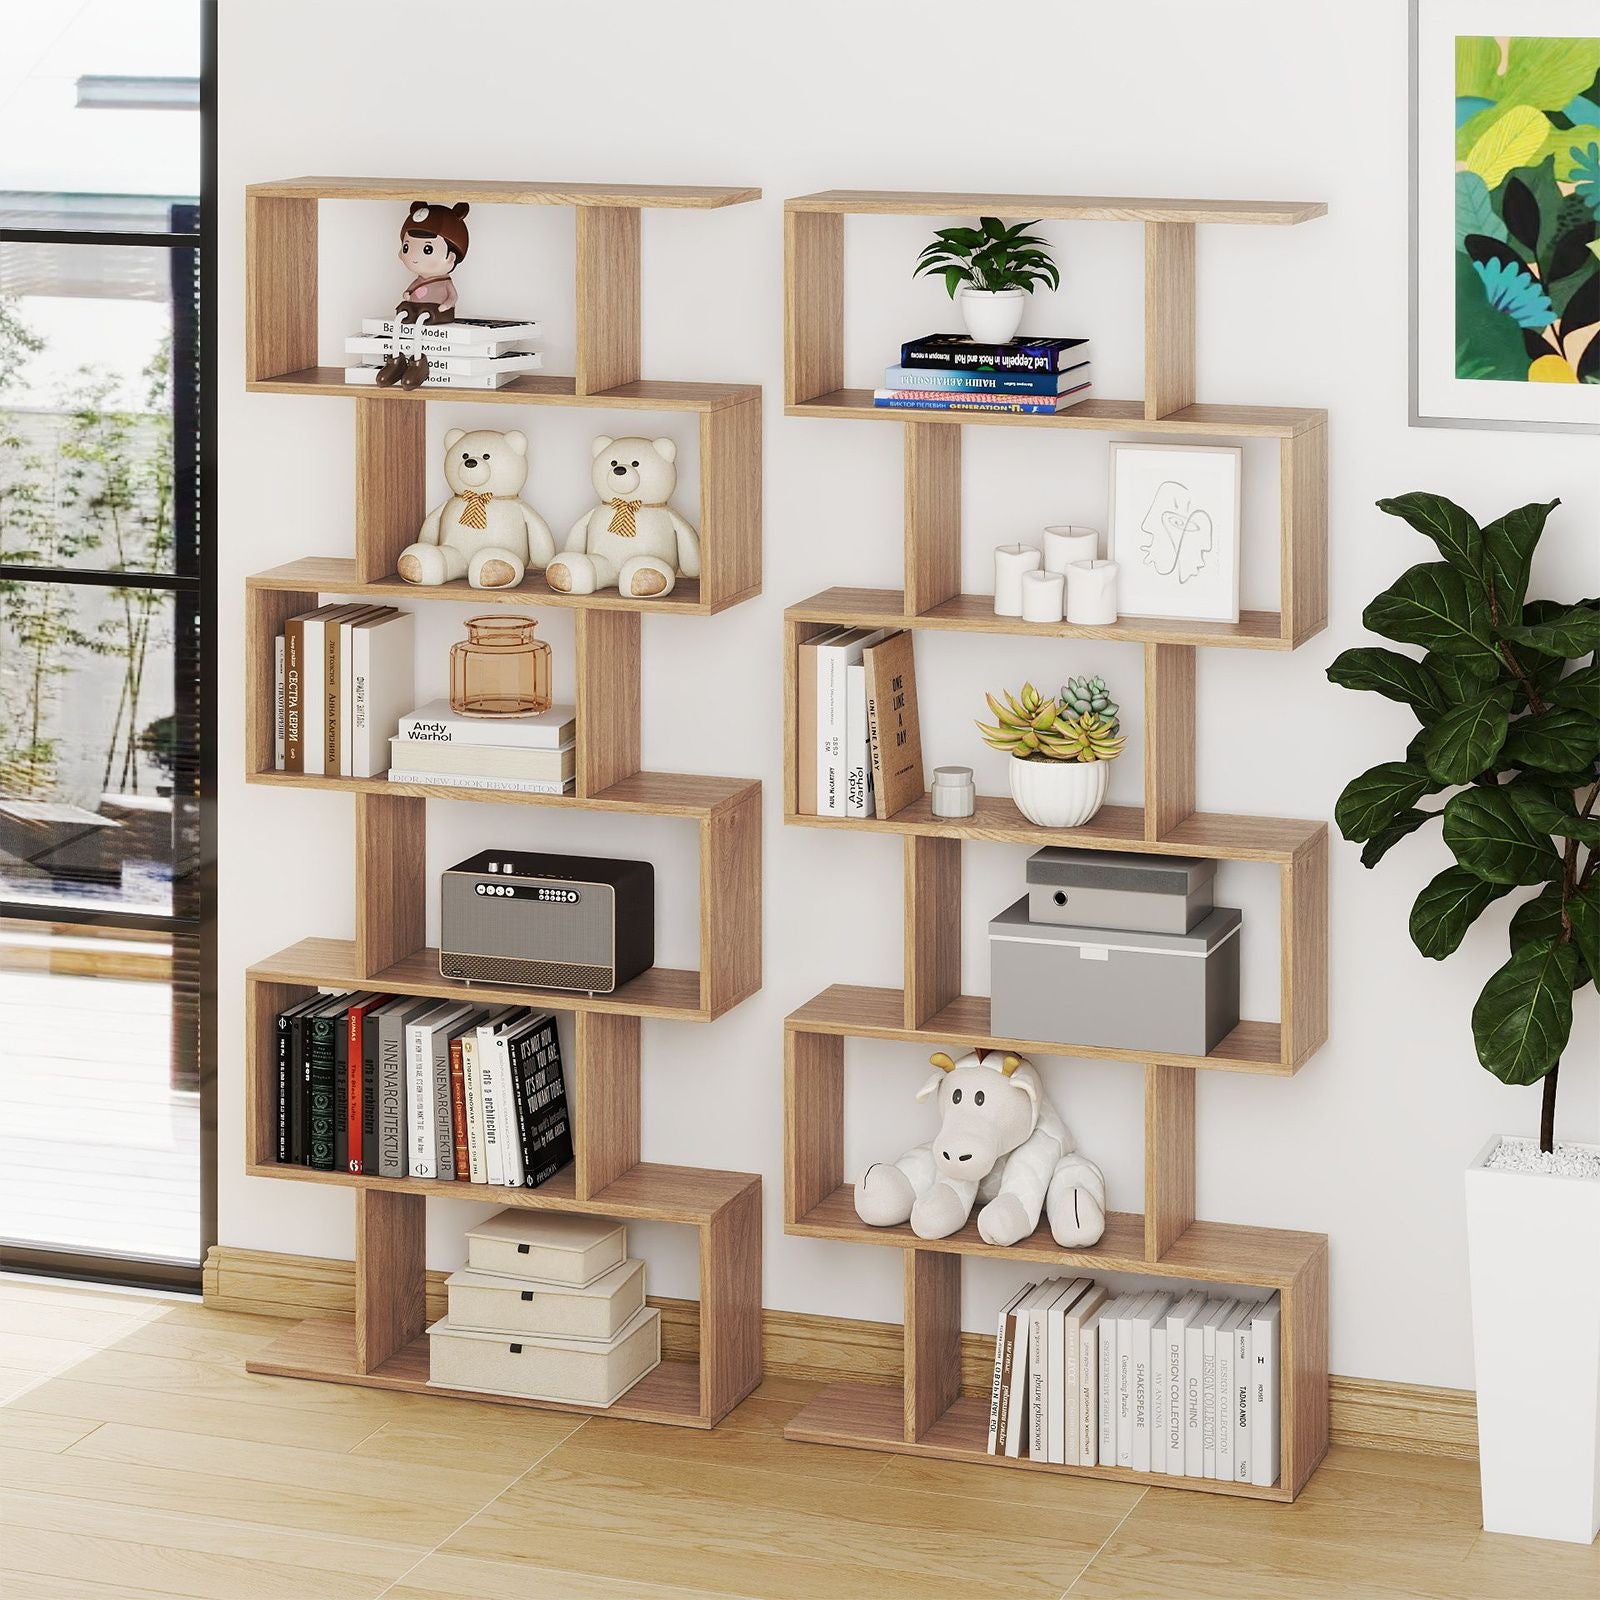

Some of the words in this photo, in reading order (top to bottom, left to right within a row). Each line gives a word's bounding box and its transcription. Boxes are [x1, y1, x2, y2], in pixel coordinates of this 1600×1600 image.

[383, 322, 414, 336] Balor
[421, 344, 450, 352] Model
[428, 360, 448, 370] odel
[954, 353, 966, 364] Roll
[967, 354, 978, 364] and
[979, 355, 994, 366] Rock
[995, 355, 1001, 366] in
[1002, 353, 1033, 368] Zeppelin
[1034, 355, 1049, 369] Led
[965, 379, 996, 388] НАШИ
[288, 670, 298, 707] СЕСТРА
[892, 674, 904, 692] ONE
[893, 692, 905, 711] LINE
[288, 710, 298, 742] КЕРРИ
[413, 722, 446, 733] Andy
[898, 712, 903, 728] A
[408, 731, 452, 742] Warhol
[897, 729, 907, 747] DAY
[825, 741, 831, 752] WS
[425, 776, 450, 785] NEW
[453, 778, 483, 787] LOOK
[486, 780, 559, 793] REVOLUTION
[848, 771, 857, 803] Andy
[856, 766, 864, 809] Warhol
[482, 1069, 492, 1085] arts
[384, 1039, 398, 1167] INNENARCHITEKTUR
[435, 1056, 451, 1171] INNENARCHITEKTUR
[485, 1097, 496, 1145] architecture
[1170, 1344, 1180, 1382] DESIGN
[1204, 1355, 1214, 1390] DESIGN
[1220, 1359, 1228, 1394] DESIGN
[1136, 1363, 1145, 1428] SHAKESPEARE
[1189, 1377, 1198, 1429] CLOTHING
[1170, 1385, 1180, 1450] COLLECTION
[1204, 1392, 1214, 1451] COLLECTION
[1220, 1396, 1228, 1455] COLLECTION
